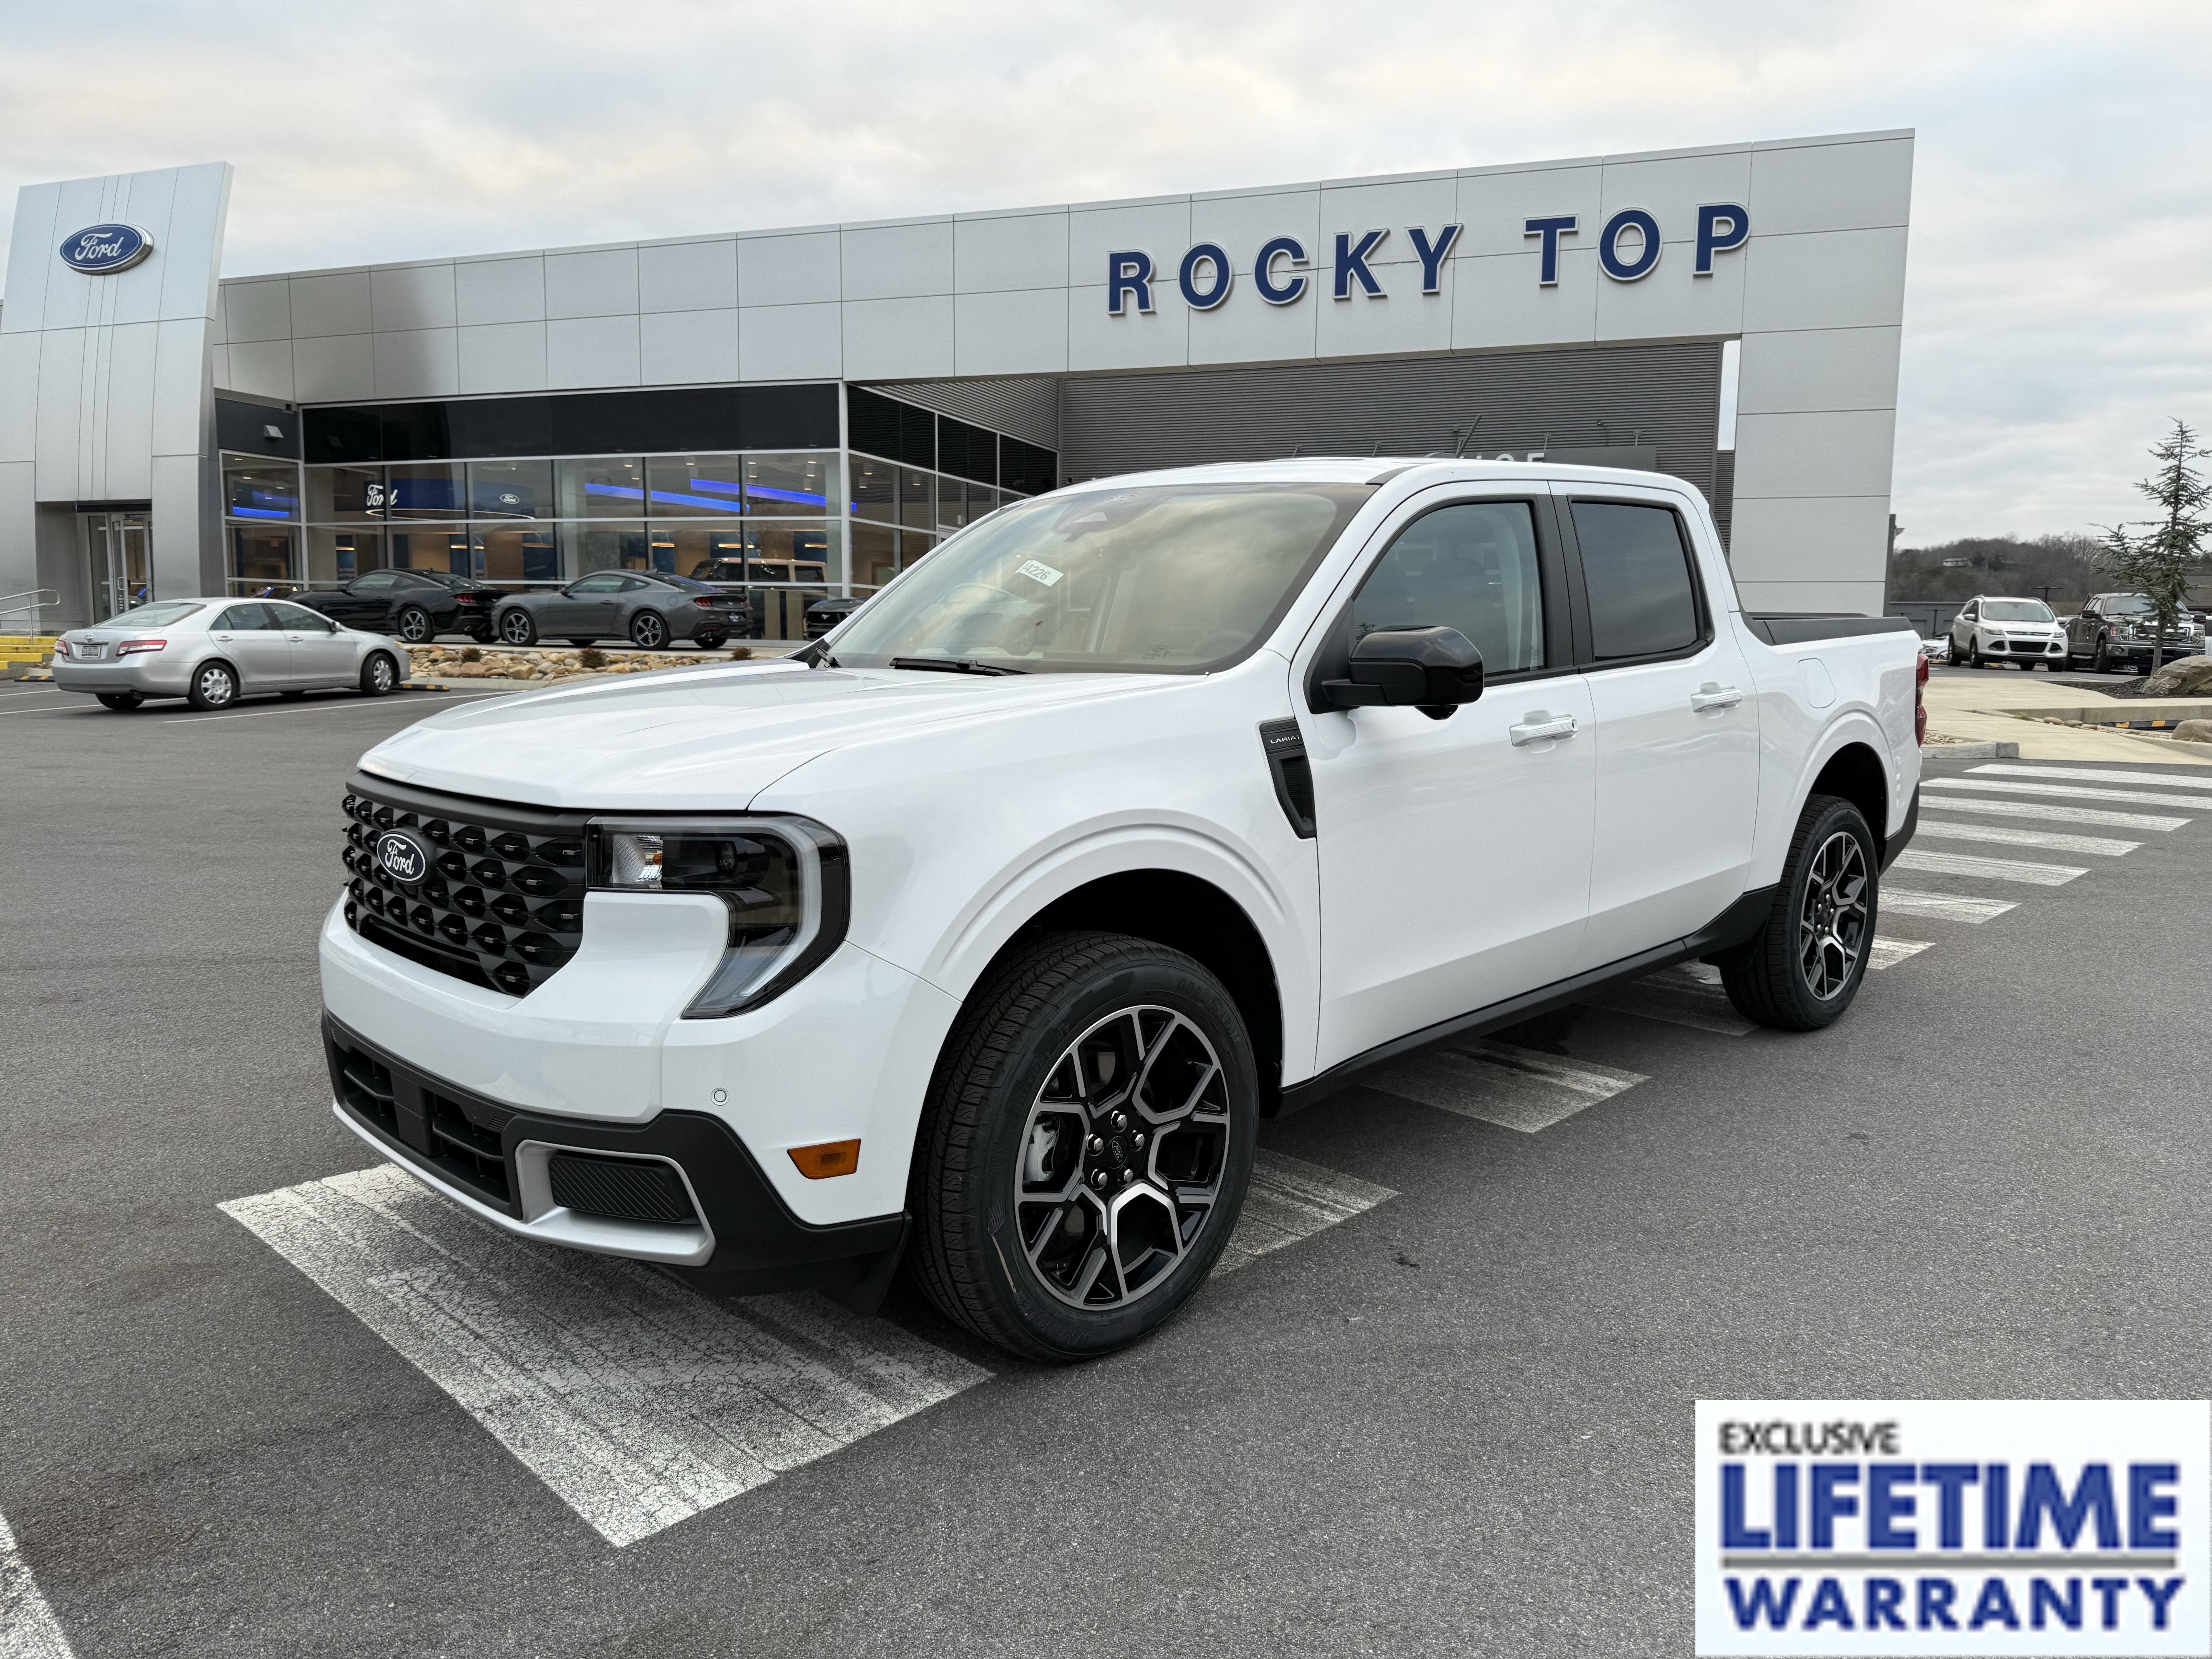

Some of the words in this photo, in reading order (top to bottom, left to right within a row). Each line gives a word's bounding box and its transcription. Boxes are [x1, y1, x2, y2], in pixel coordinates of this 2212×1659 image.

[75, 232, 124, 261] Ford
[1108, 223, 1463, 315] ROCKY
[1523, 202, 1751, 286] TOP
[1270, 735, 1300, 744] LARIAT
[385, 839, 414, 875] Ford
